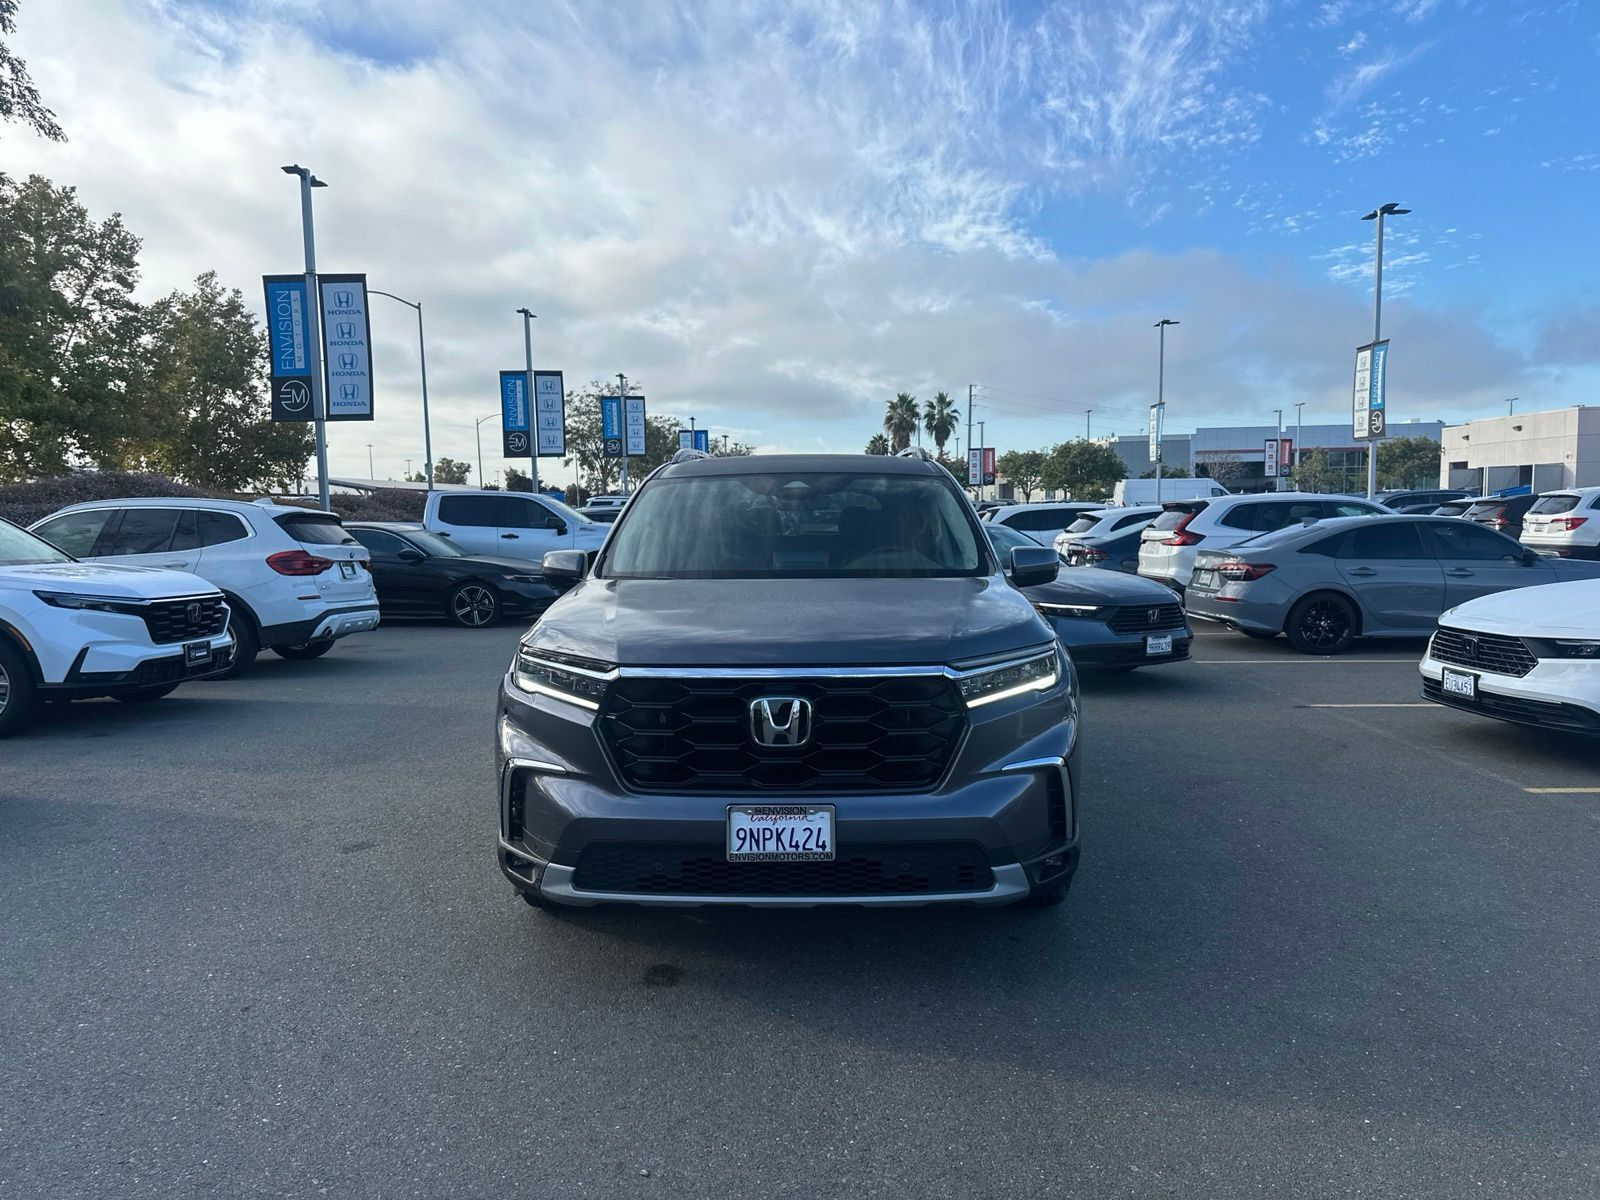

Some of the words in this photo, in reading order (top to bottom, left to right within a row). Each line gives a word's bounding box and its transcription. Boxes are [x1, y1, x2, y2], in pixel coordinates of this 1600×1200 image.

[275, 290, 294, 370] ENVISION
[293, 296, 303, 363] MOTORS
[1372, 351, 1382, 405] ENVISION
[507, 379, 517, 427] ENVISION
[606, 401, 614, 436] ENVISION
[750, 814, 814, 826] California
[760, 807, 807, 815] ENVISION
[736, 827, 827, 851] 9NPK424
[729, 852, 833, 862] ENVISIONMOTORS.COM
